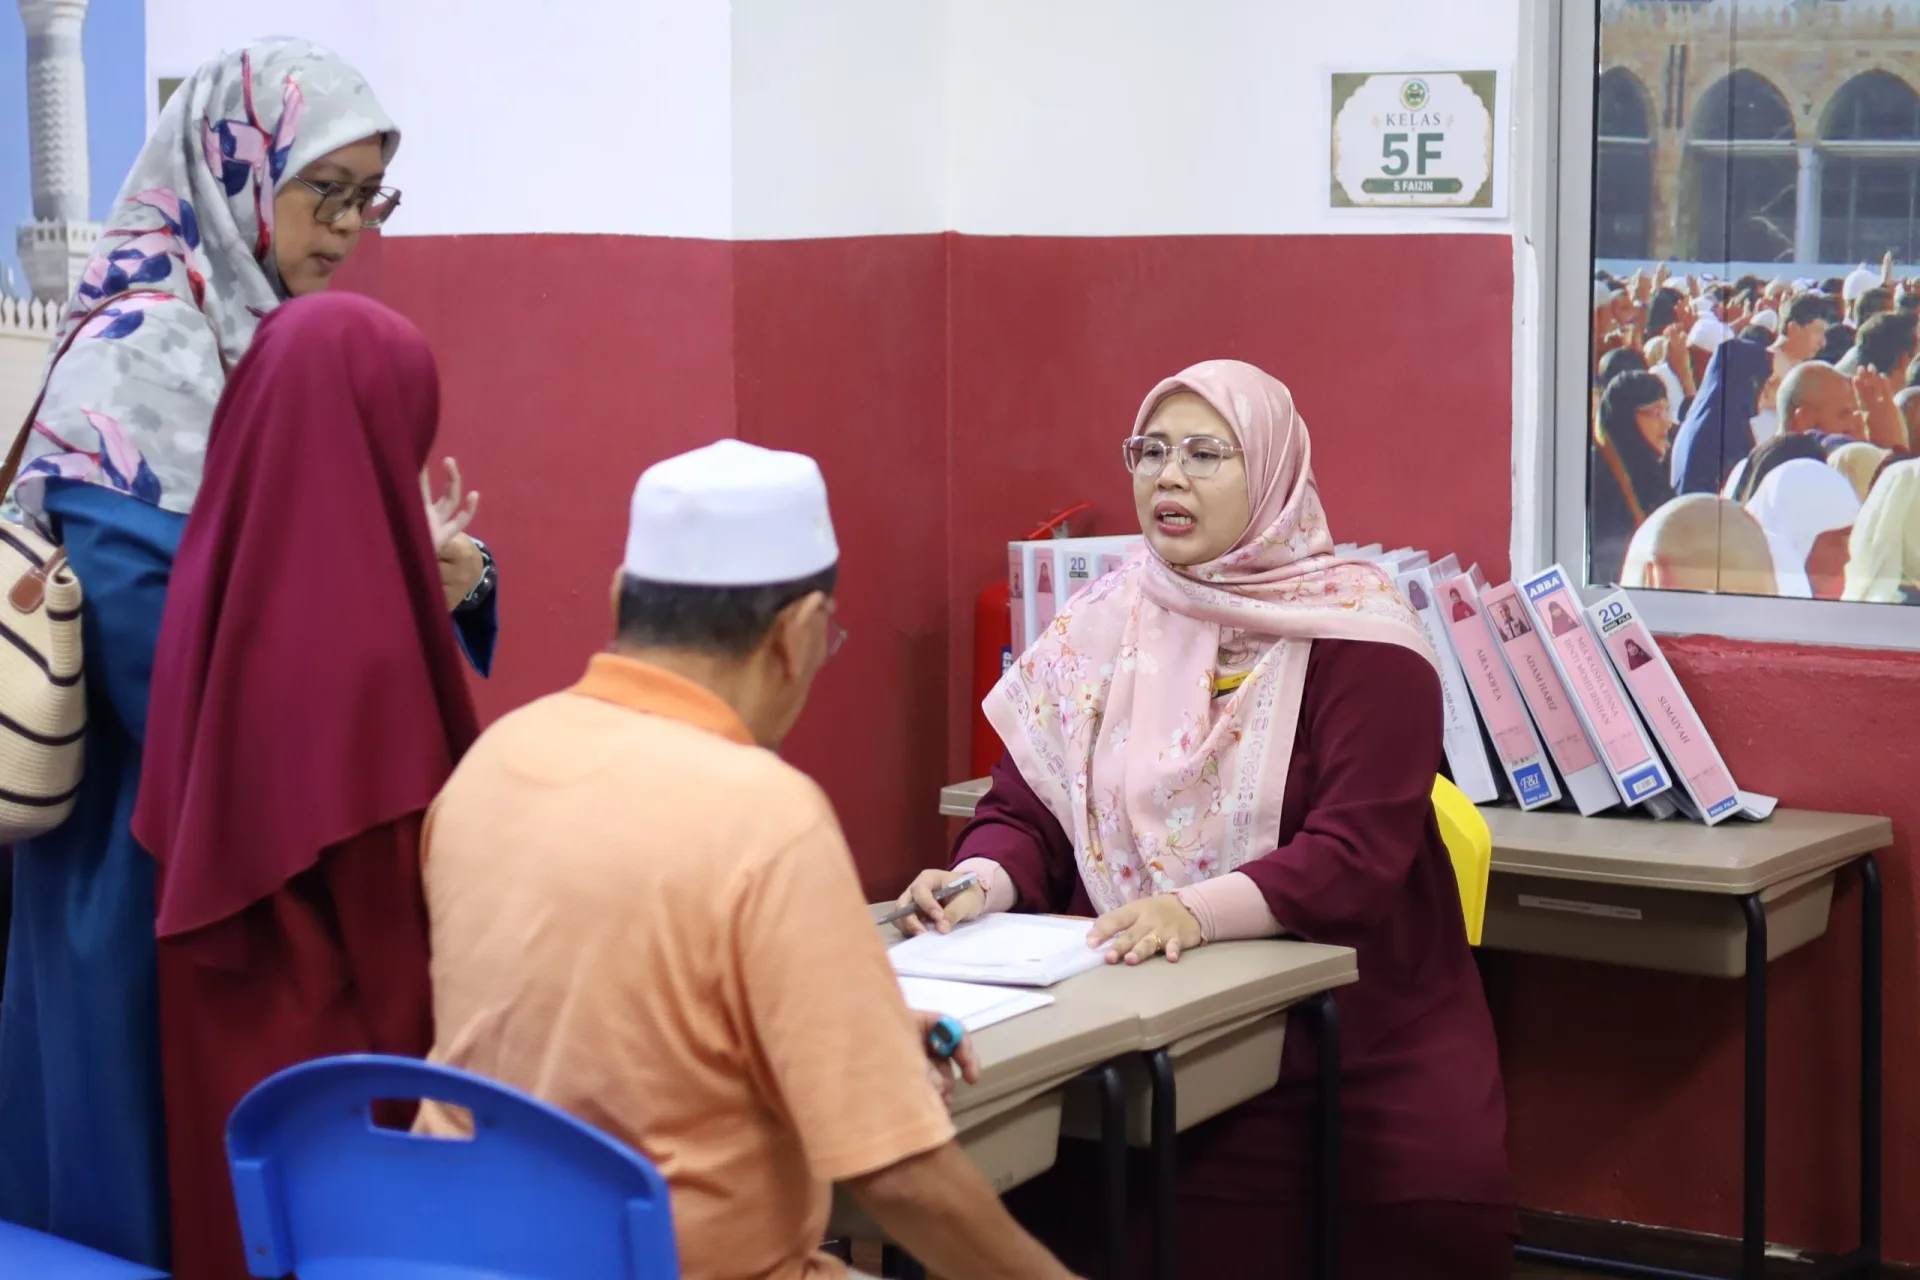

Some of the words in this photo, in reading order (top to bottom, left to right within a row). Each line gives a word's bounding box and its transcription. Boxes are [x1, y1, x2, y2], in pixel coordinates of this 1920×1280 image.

[1386, 113, 1441, 127] KELAS
[1380, 133, 1444, 176] 5F
[1402, 181, 1433, 191] FAIZIN
[1070, 557, 1086, 570] 2D
[1528, 577, 1560, 597] ABBA
[1598, 601, 1624, 623] 2D
[1618, 614, 1632, 625] FILE
[1474, 647, 1490, 671] AIRA
[1484, 670, 1503, 701] SOFEA
[1523, 653, 1543, 683] ADAM
[1537, 682, 1557, 712] HARIZ
[1657, 695, 1690, 744] SUMAIYAH
